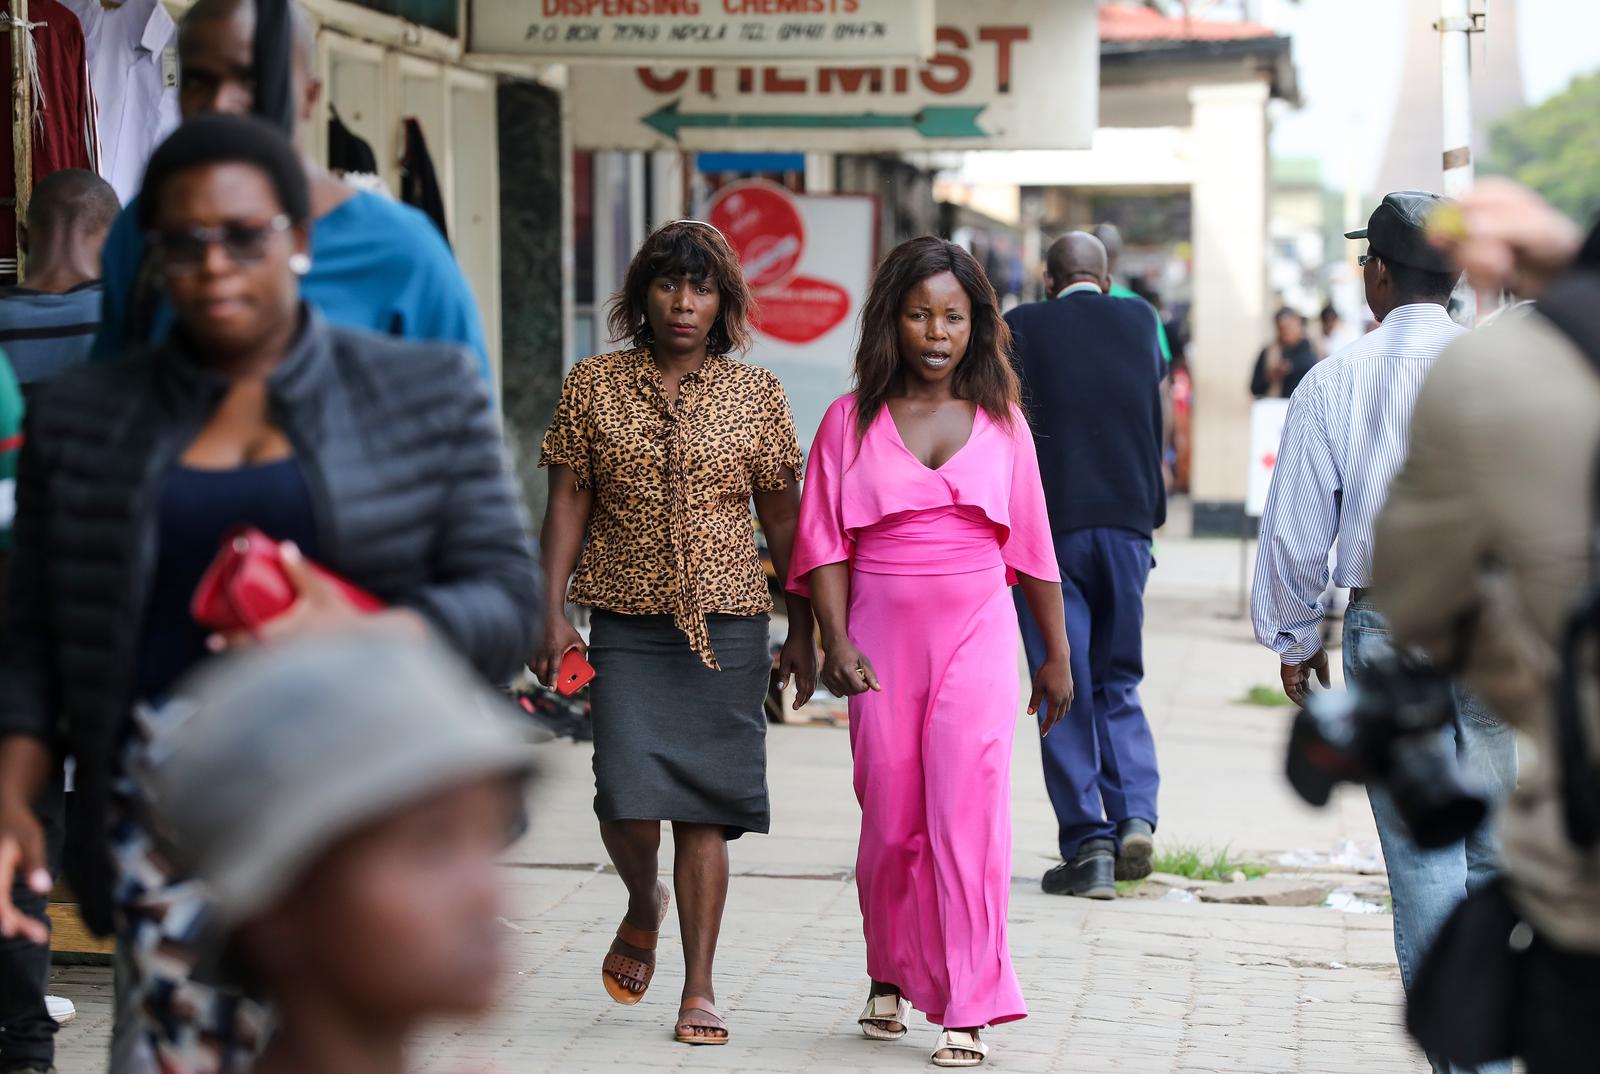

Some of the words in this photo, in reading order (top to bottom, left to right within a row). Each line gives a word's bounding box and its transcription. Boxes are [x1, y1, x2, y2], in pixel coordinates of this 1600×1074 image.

[542, 0, 701, 16] DISPENSING
[722, 0, 858, 15] CHEMISTS
[563, 23, 601, 41] BOX
